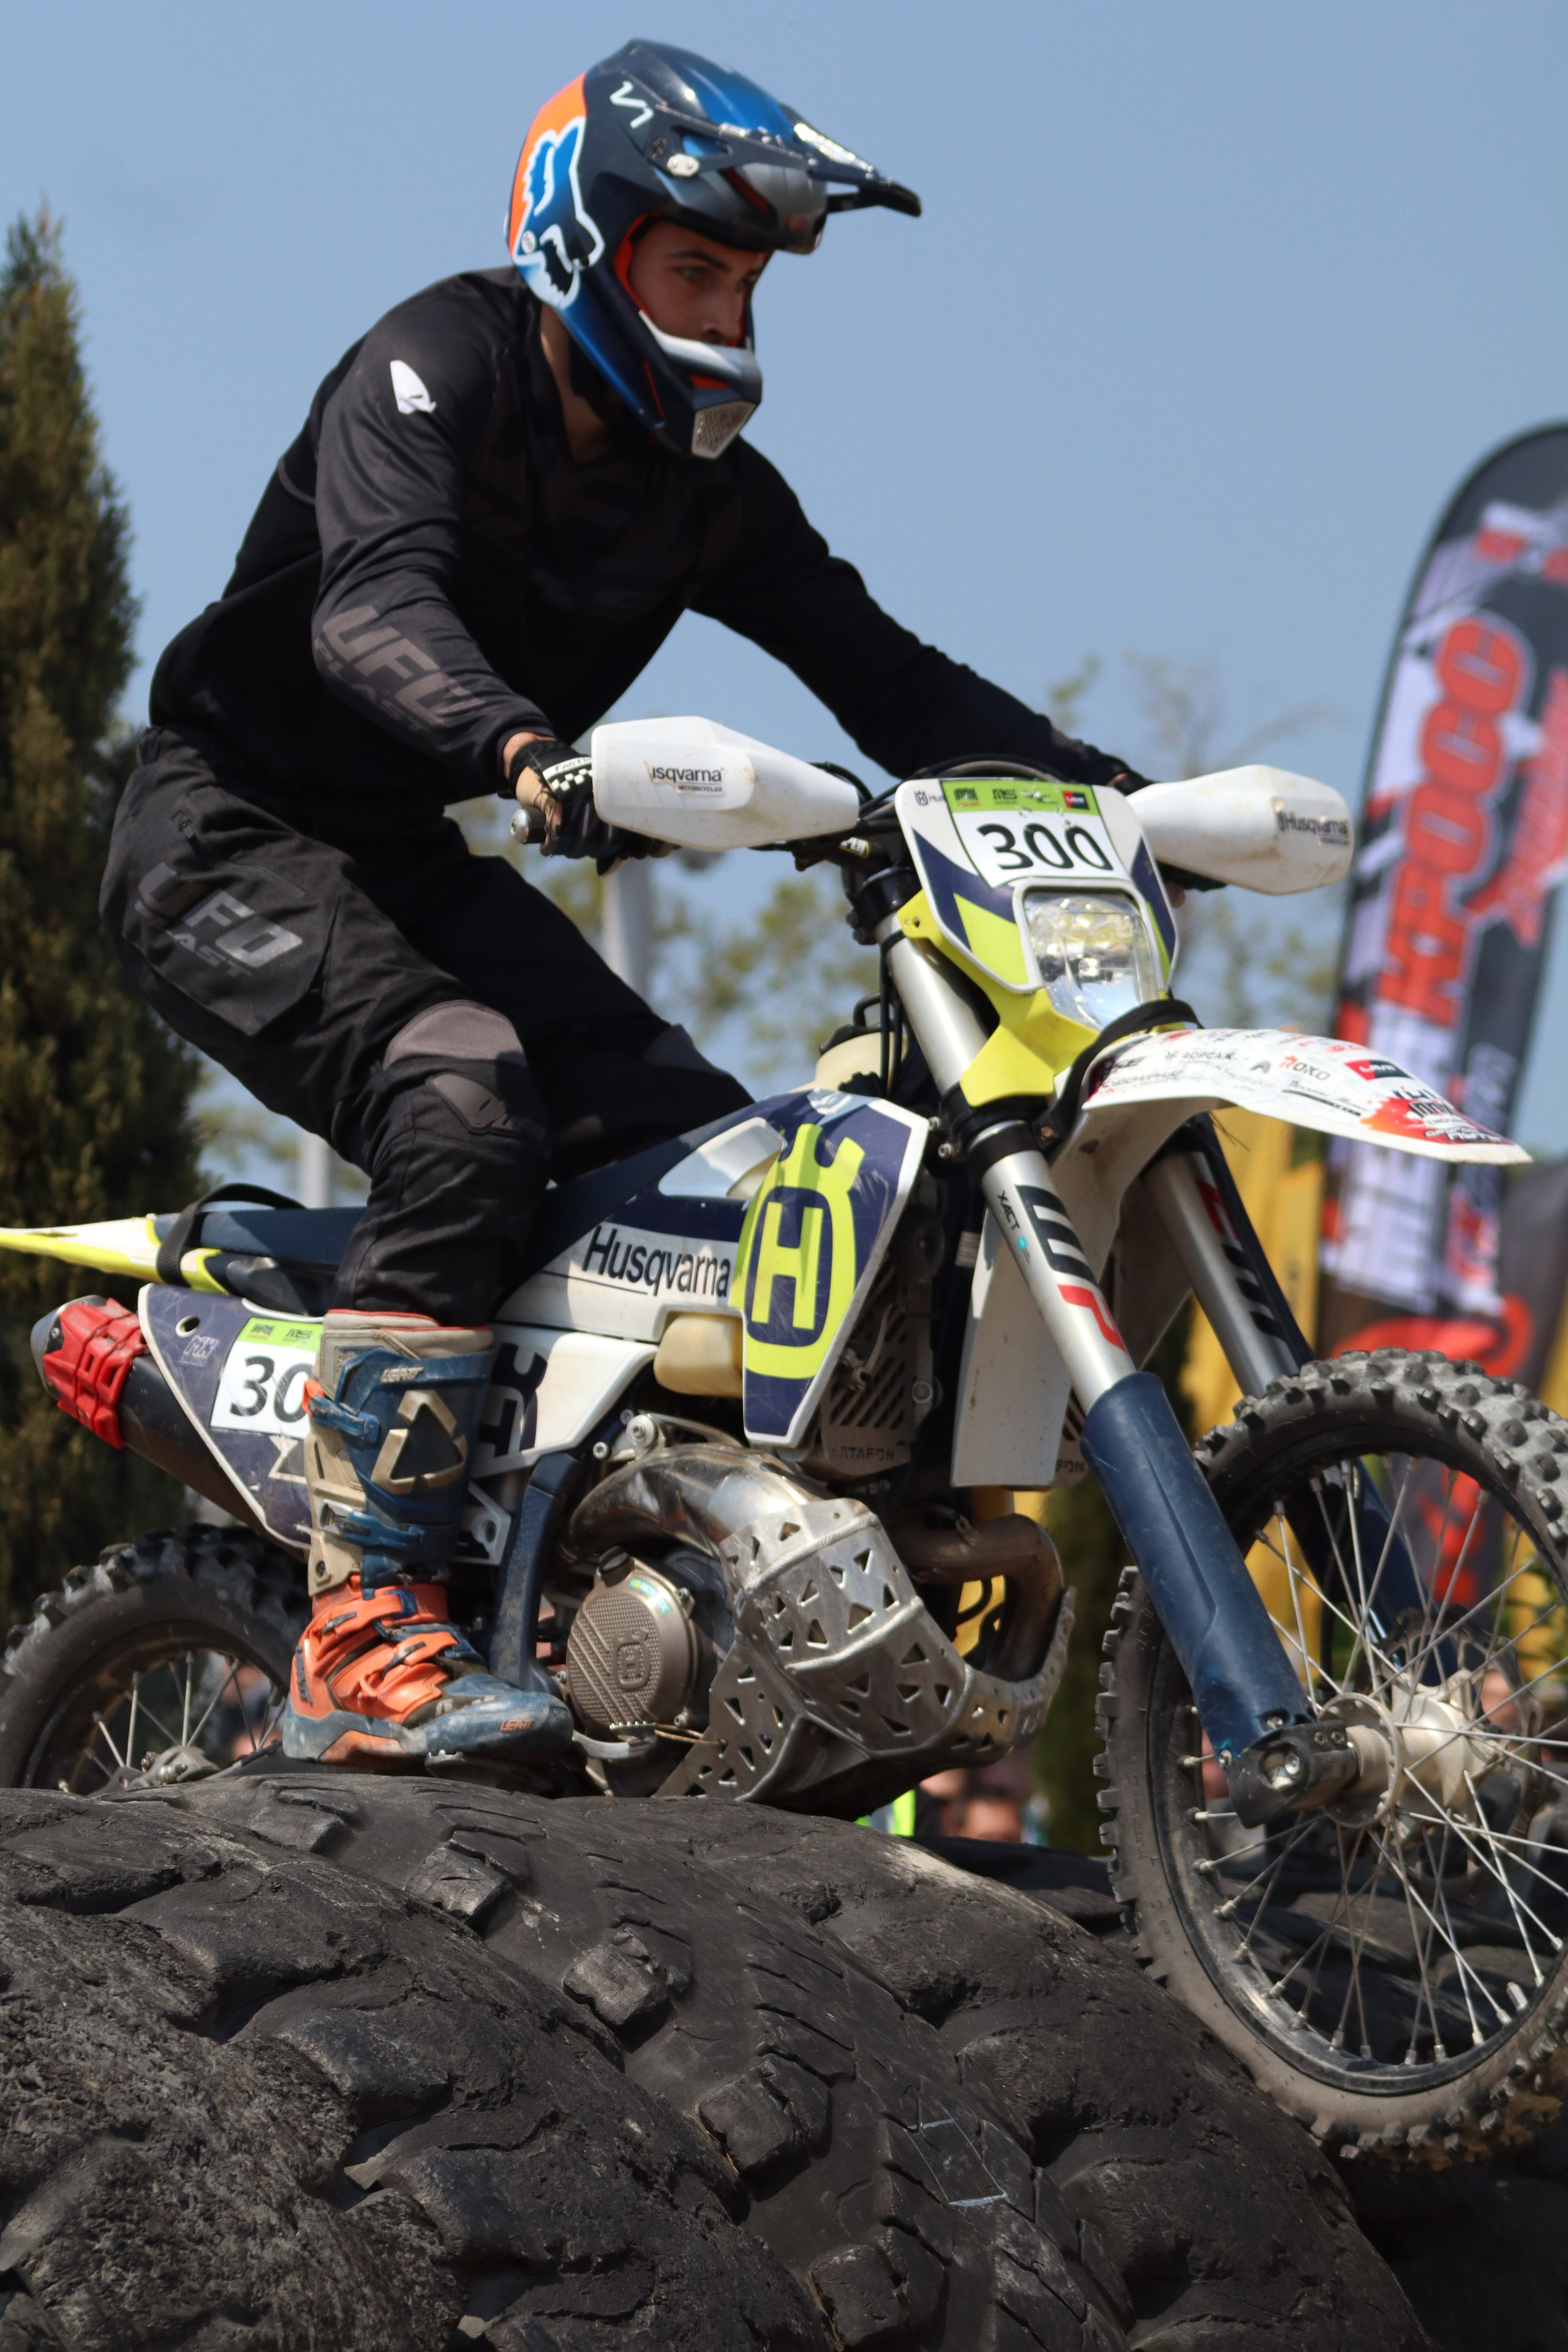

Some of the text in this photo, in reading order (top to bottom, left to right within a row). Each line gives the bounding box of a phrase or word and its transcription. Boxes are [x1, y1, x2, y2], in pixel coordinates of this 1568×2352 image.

[322, 605, 488, 727] UFO
[652, 766, 723, 782] sqvarna
[976, 823, 1113, 870] 300
[997, 1189, 1020, 1230] XACT
[582, 1226, 731, 1297] Husqvarna
[229, 1355, 314, 1423] 30
